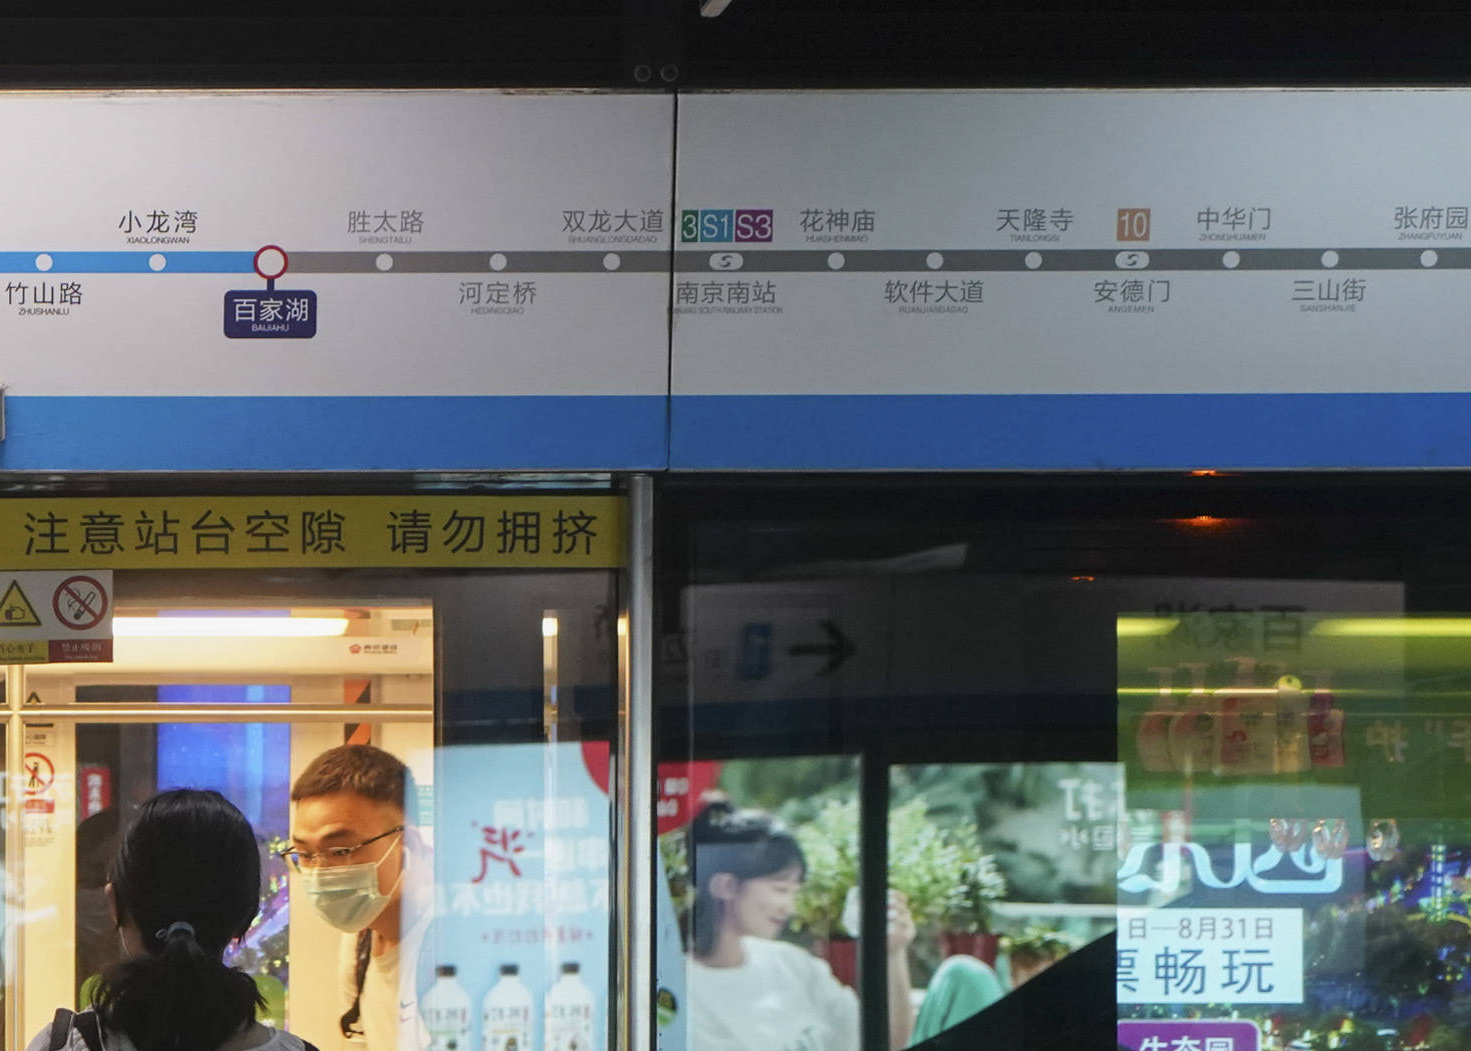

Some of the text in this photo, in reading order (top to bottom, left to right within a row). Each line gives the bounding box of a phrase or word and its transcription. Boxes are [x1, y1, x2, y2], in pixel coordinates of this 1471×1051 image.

[119, 210, 197, 233] 小龙湾
[348, 210, 424, 233] 胜太路
[563, 209, 663, 232] 双龙大道
[683, 212, 771, 240] 3 S1 S3
[800, 208, 875, 232] 花神庙
[997, 208, 1073, 231] 天隆寺
[1121, 211, 1147, 239] 10
[1197, 207, 1270, 231] 中华门
[1394, 206, 1468, 229] 张府园
[6, 282, 82, 305] 竹山路
[459, 281, 536, 304] 河定桥
[677, 280, 776, 304] 南京南站
[884, 280, 983, 303] 软件大道
[1094, 280, 1170, 302] 安德门
[1292, 278, 1366, 302] 三山街
[234, 298, 308, 321] 百家湖
[24, 509, 597, 555] 注意站台空隙 请勿拥挤
